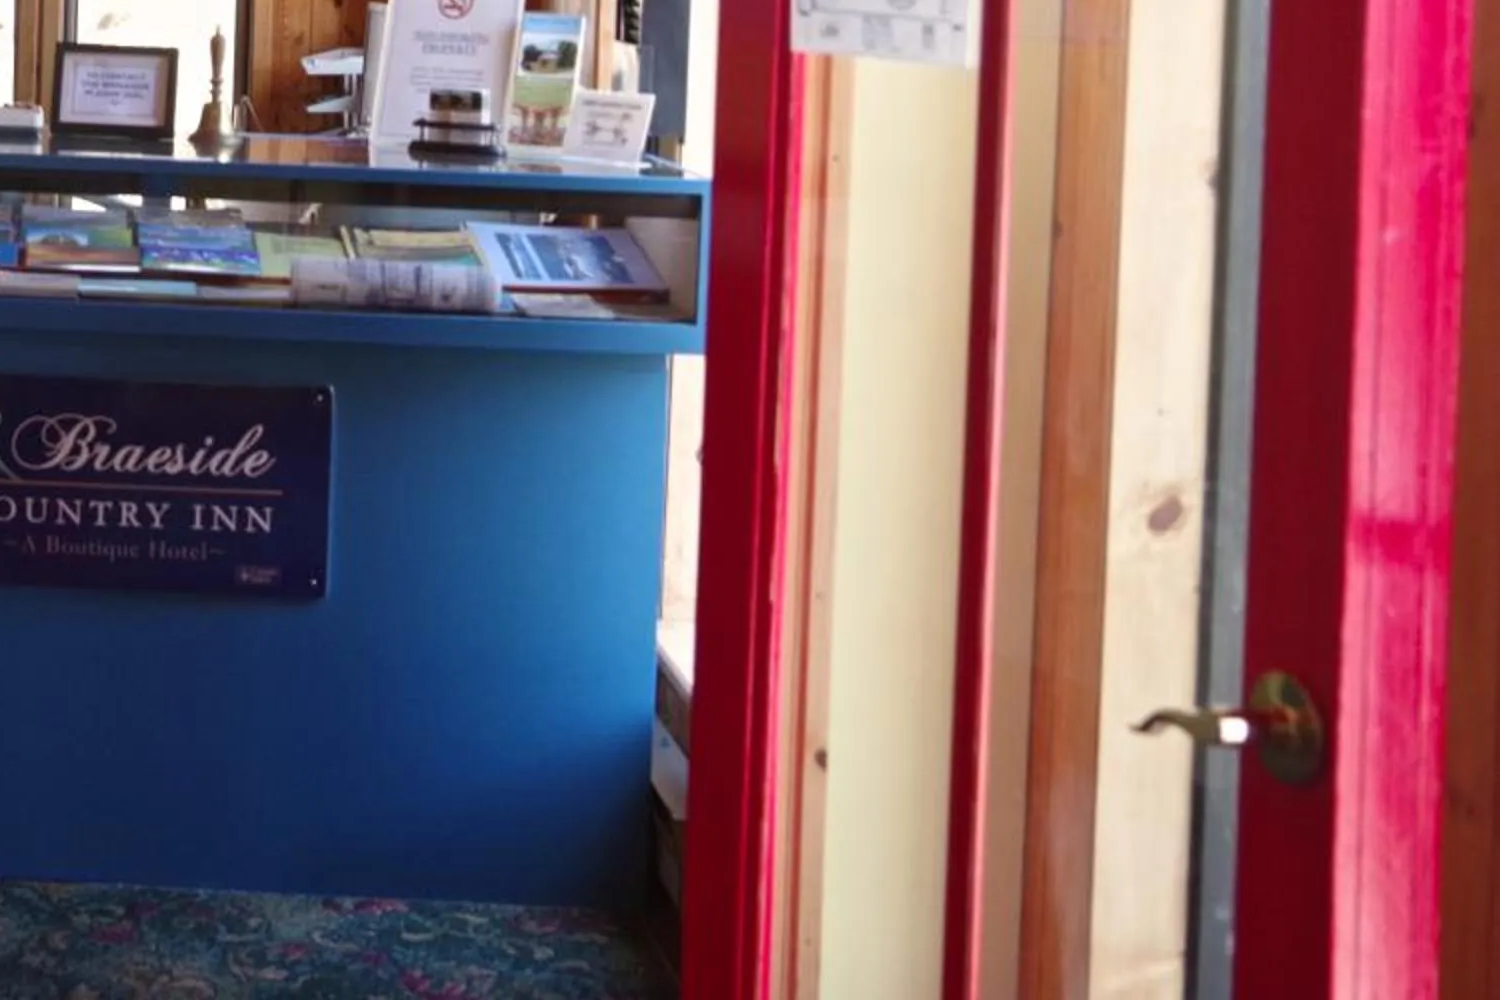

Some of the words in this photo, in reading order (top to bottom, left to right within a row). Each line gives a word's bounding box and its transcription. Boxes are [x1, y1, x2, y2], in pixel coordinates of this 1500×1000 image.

[11, 412, 276, 478] Braeside
[192, 504, 275, 533] INN
[46, 534, 140, 562] Boutique
